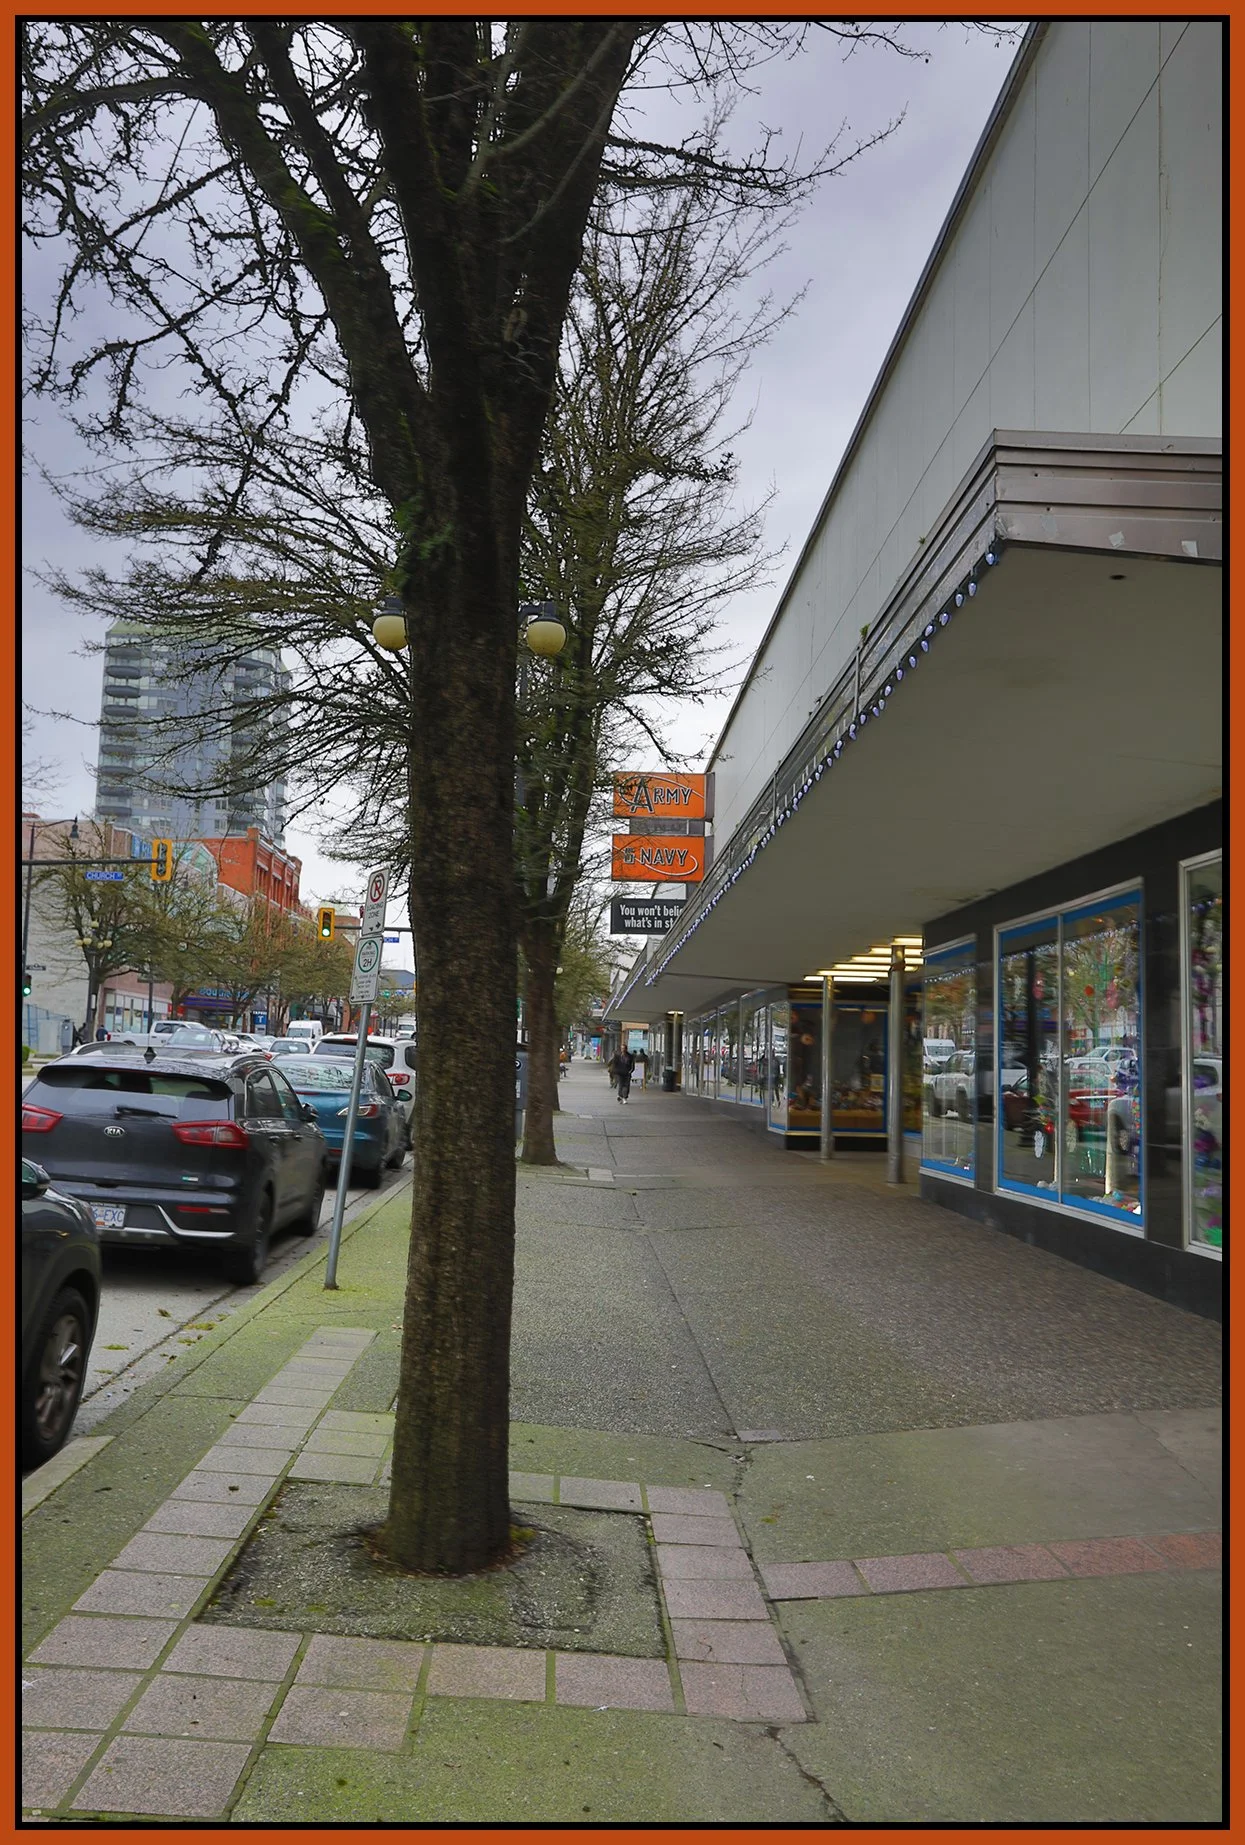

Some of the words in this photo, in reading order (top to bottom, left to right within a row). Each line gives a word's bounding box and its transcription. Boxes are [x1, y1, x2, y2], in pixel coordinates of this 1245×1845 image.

[630, 776, 692, 814] ARMY
[640, 847, 689, 867] NAVY
[86, 872, 115, 880] CHURCH
[368, 911, 380, 919] ZONE
[619, 904, 636, 916] You
[637, 904, 661, 916] won't
[624, 917, 652, 928] what's
[654, 917, 663, 928] in
[362, 958, 373, 967] 2H
[103, 1209, 124, 1222] EXC
